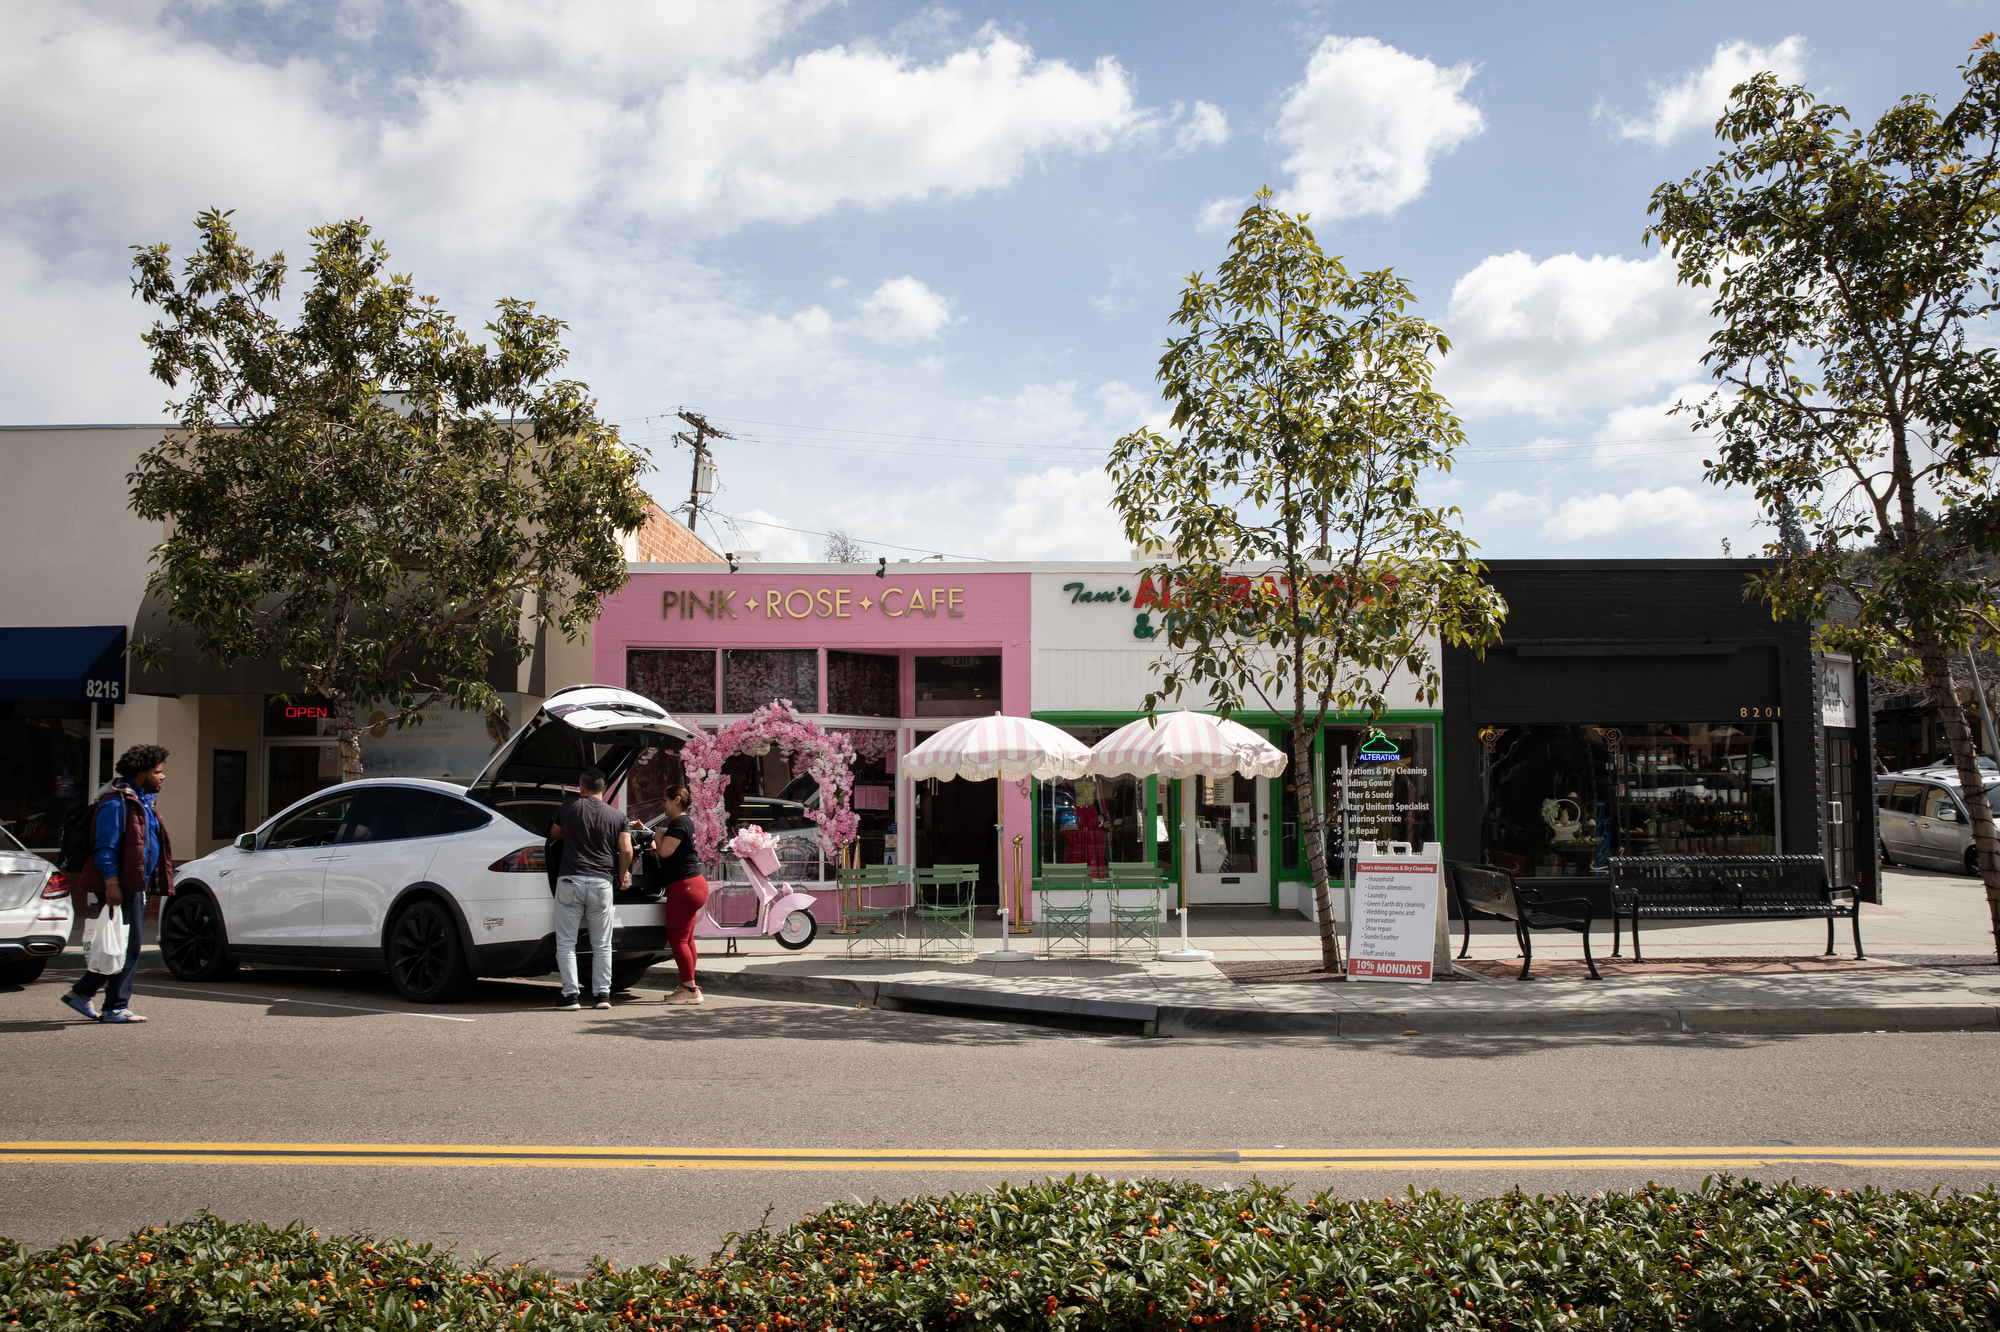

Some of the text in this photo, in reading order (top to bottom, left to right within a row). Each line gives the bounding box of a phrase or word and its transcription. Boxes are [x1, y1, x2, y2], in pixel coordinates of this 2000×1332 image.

[1063, 582, 1132, 604] Tam's
[662, 587, 964, 619] PINK ROSE CAFE
[1133, 613, 1156, 639] &
[86, 679, 119, 699] 8215
[420, 704, 439, 712] etter
[1824, 699, 1841, 713] CRAFT
[285, 707, 327, 718] OPEN
[1740, 707, 1781, 718] 8201
[427, 714, 444, 722] Way
[1376, 767, 1383, 775] &
[1383, 767, 1395, 777] Dry
[1396, 767, 1428, 777] Cleaning
[1336, 779, 1393, 788] Wdding Gowns
[1336, 791, 1394, 799] Lther & Suede
[1366, 803, 1395, 811] Uniform
[1395, 802, 1430, 812] Specialist
[1376, 815, 1402, 823] Service
[1337, 827, 1380, 837] Se Repair
[1412, 865, 1433, 873] Cleaning
[1725, 869, 1768, 878] MESA
[1367, 892, 1387, 900] Laundry
[1395, 901, 1404, 909] dry
[1404, 902, 1425, 910] cleaning
[1366, 909, 1388, 917] Wedding
[1364, 933, 1399, 941] Suede/Leather
[1356, 960, 1423, 975] 10% MONDAYS
